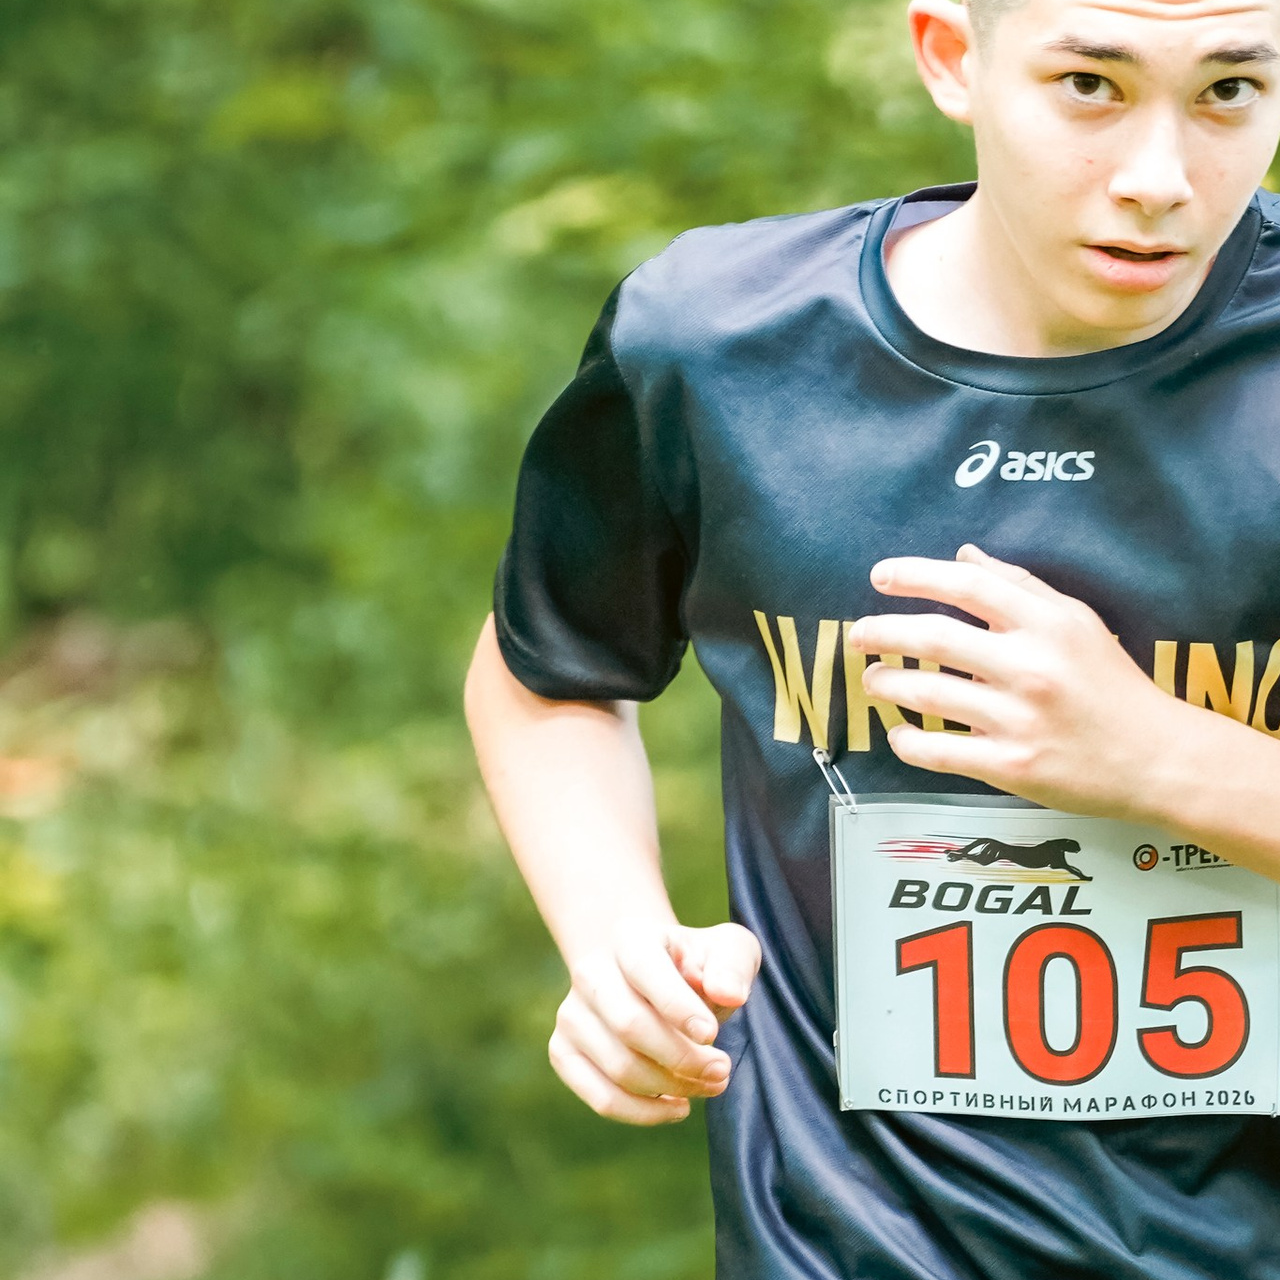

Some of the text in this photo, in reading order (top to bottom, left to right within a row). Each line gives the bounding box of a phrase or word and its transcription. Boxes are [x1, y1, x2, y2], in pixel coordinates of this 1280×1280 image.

[1000, 450, 1096, 481] asics
[888, 878, 1093, 916] BOGAL
[895, 910, 1250, 1086] 105
[878, 1088, 1255, 1113] СПОРТИВНЫЙ МАРАФОН 2026
